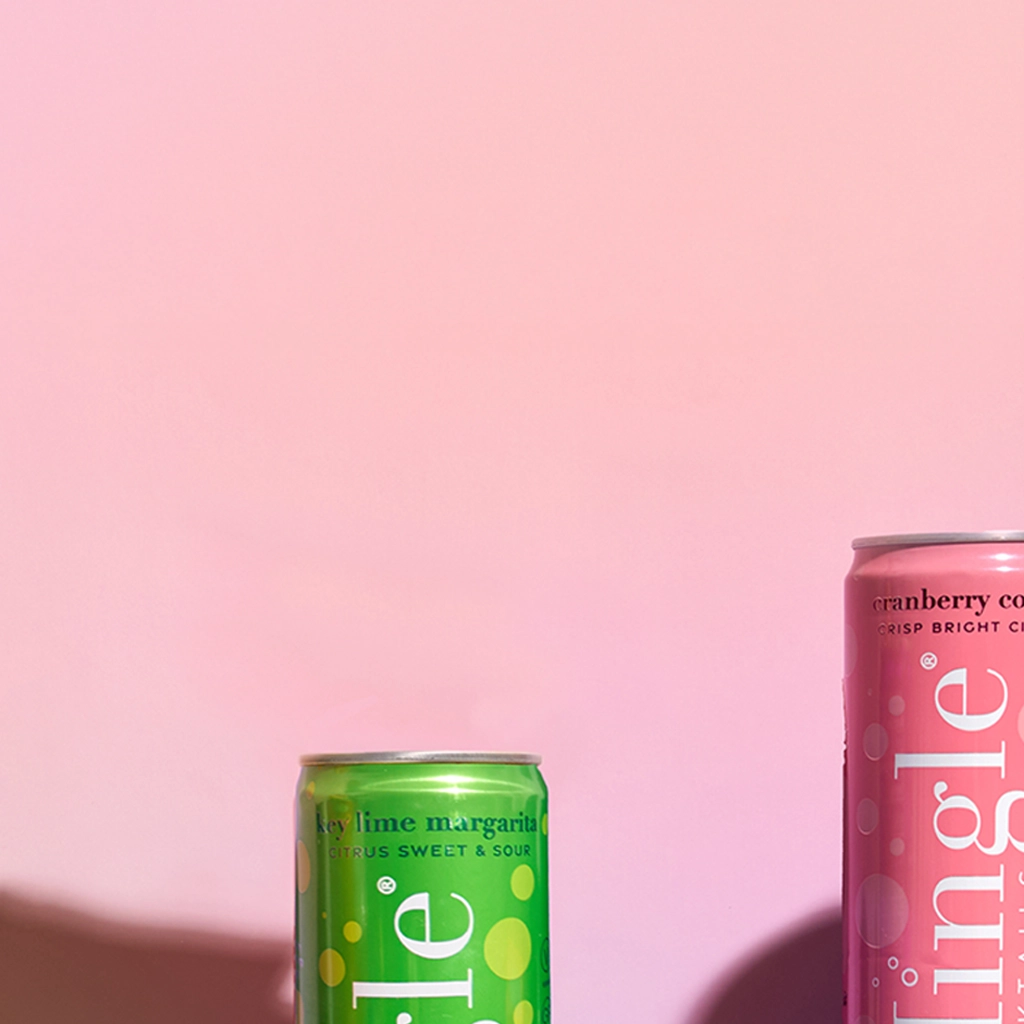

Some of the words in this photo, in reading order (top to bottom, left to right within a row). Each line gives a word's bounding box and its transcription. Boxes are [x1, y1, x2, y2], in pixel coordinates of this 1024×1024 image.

[873, 588, 990, 617] cranberry
[878, 622, 923, 635] CRISP
[932, 621, 1000, 633] BRIGHT
[317, 811, 352, 841] key
[357, 810, 416, 833] lime
[426, 811, 538, 840] margarita
[329, 845, 389, 858] CITRUS
[398, 844, 467, 857] SWEET
[475, 845, 486, 857] &
[493, 844, 531, 857] SOUR
